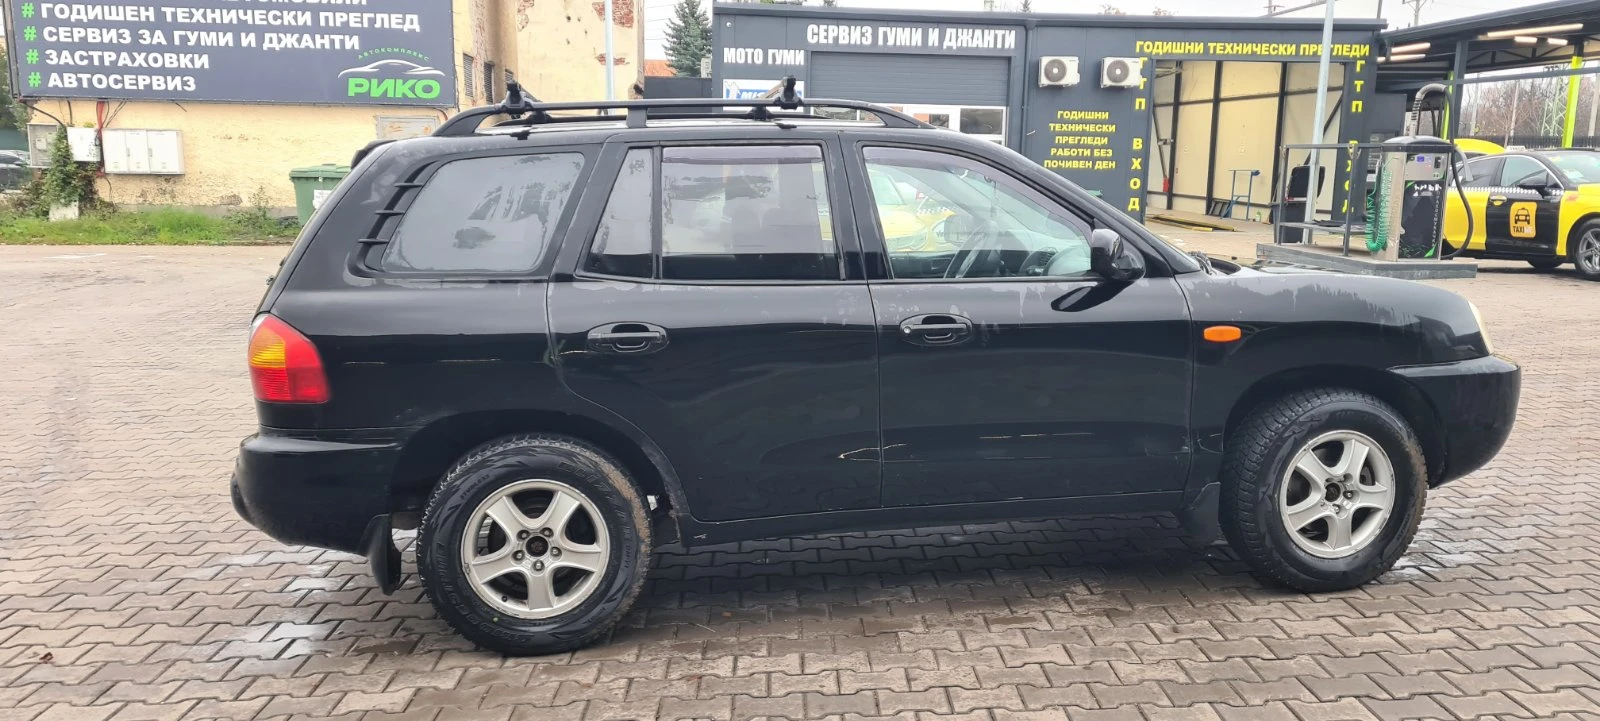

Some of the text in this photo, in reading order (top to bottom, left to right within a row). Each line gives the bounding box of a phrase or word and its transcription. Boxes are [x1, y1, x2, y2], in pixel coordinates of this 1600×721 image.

[40, 2, 155, 23] ГОДИШЕН
[161, 6, 312, 27] ТЕХНИЧЕСКИ
[319, 11, 421, 32] ПРЕГЛЕД
[42, 26, 132, 45] СЕРВИЗ
[140, 29, 167, 45] ЗА
[173, 30, 234, 47] ГУМИ
[240, 32, 257, 48] И
[262, 32, 360, 51] ДЖАНТИ
[806, 24, 1016, 50] СЕРВИЗ ГУМИ И ДЖАНТИ
[357, 47, 431, 62] АВТОКОМПЛЕКС
[723, 47, 805, 66] МОТО ГУМИ
[1135, 40, 1370, 59] ГОДИШНИ ТЕХНИЧЕСКИ ПРЕЛЕДИ
[44, 49, 210, 70] ЗАСТРАХОВКИ
[47, 72, 196, 92] АВТОСЕРВИЗ
[347, 77, 441, 100] РИКО
[1351, 60, 1366, 113] ГТП
[1057, 111, 1109, 120] ГОДИШНИ
[1049, 123, 1116, 133] ТЕХНИЧЕСКИ
[1055, 136, 1109, 146] ПРЕГЛЕДИ
[1050, 148, 1113, 158] РАБОТИ БЕЗ
[1044, 160, 1116, 170] ПОЧИВЕН ДЕН
[1127, 138, 1143, 212] ВХОД
